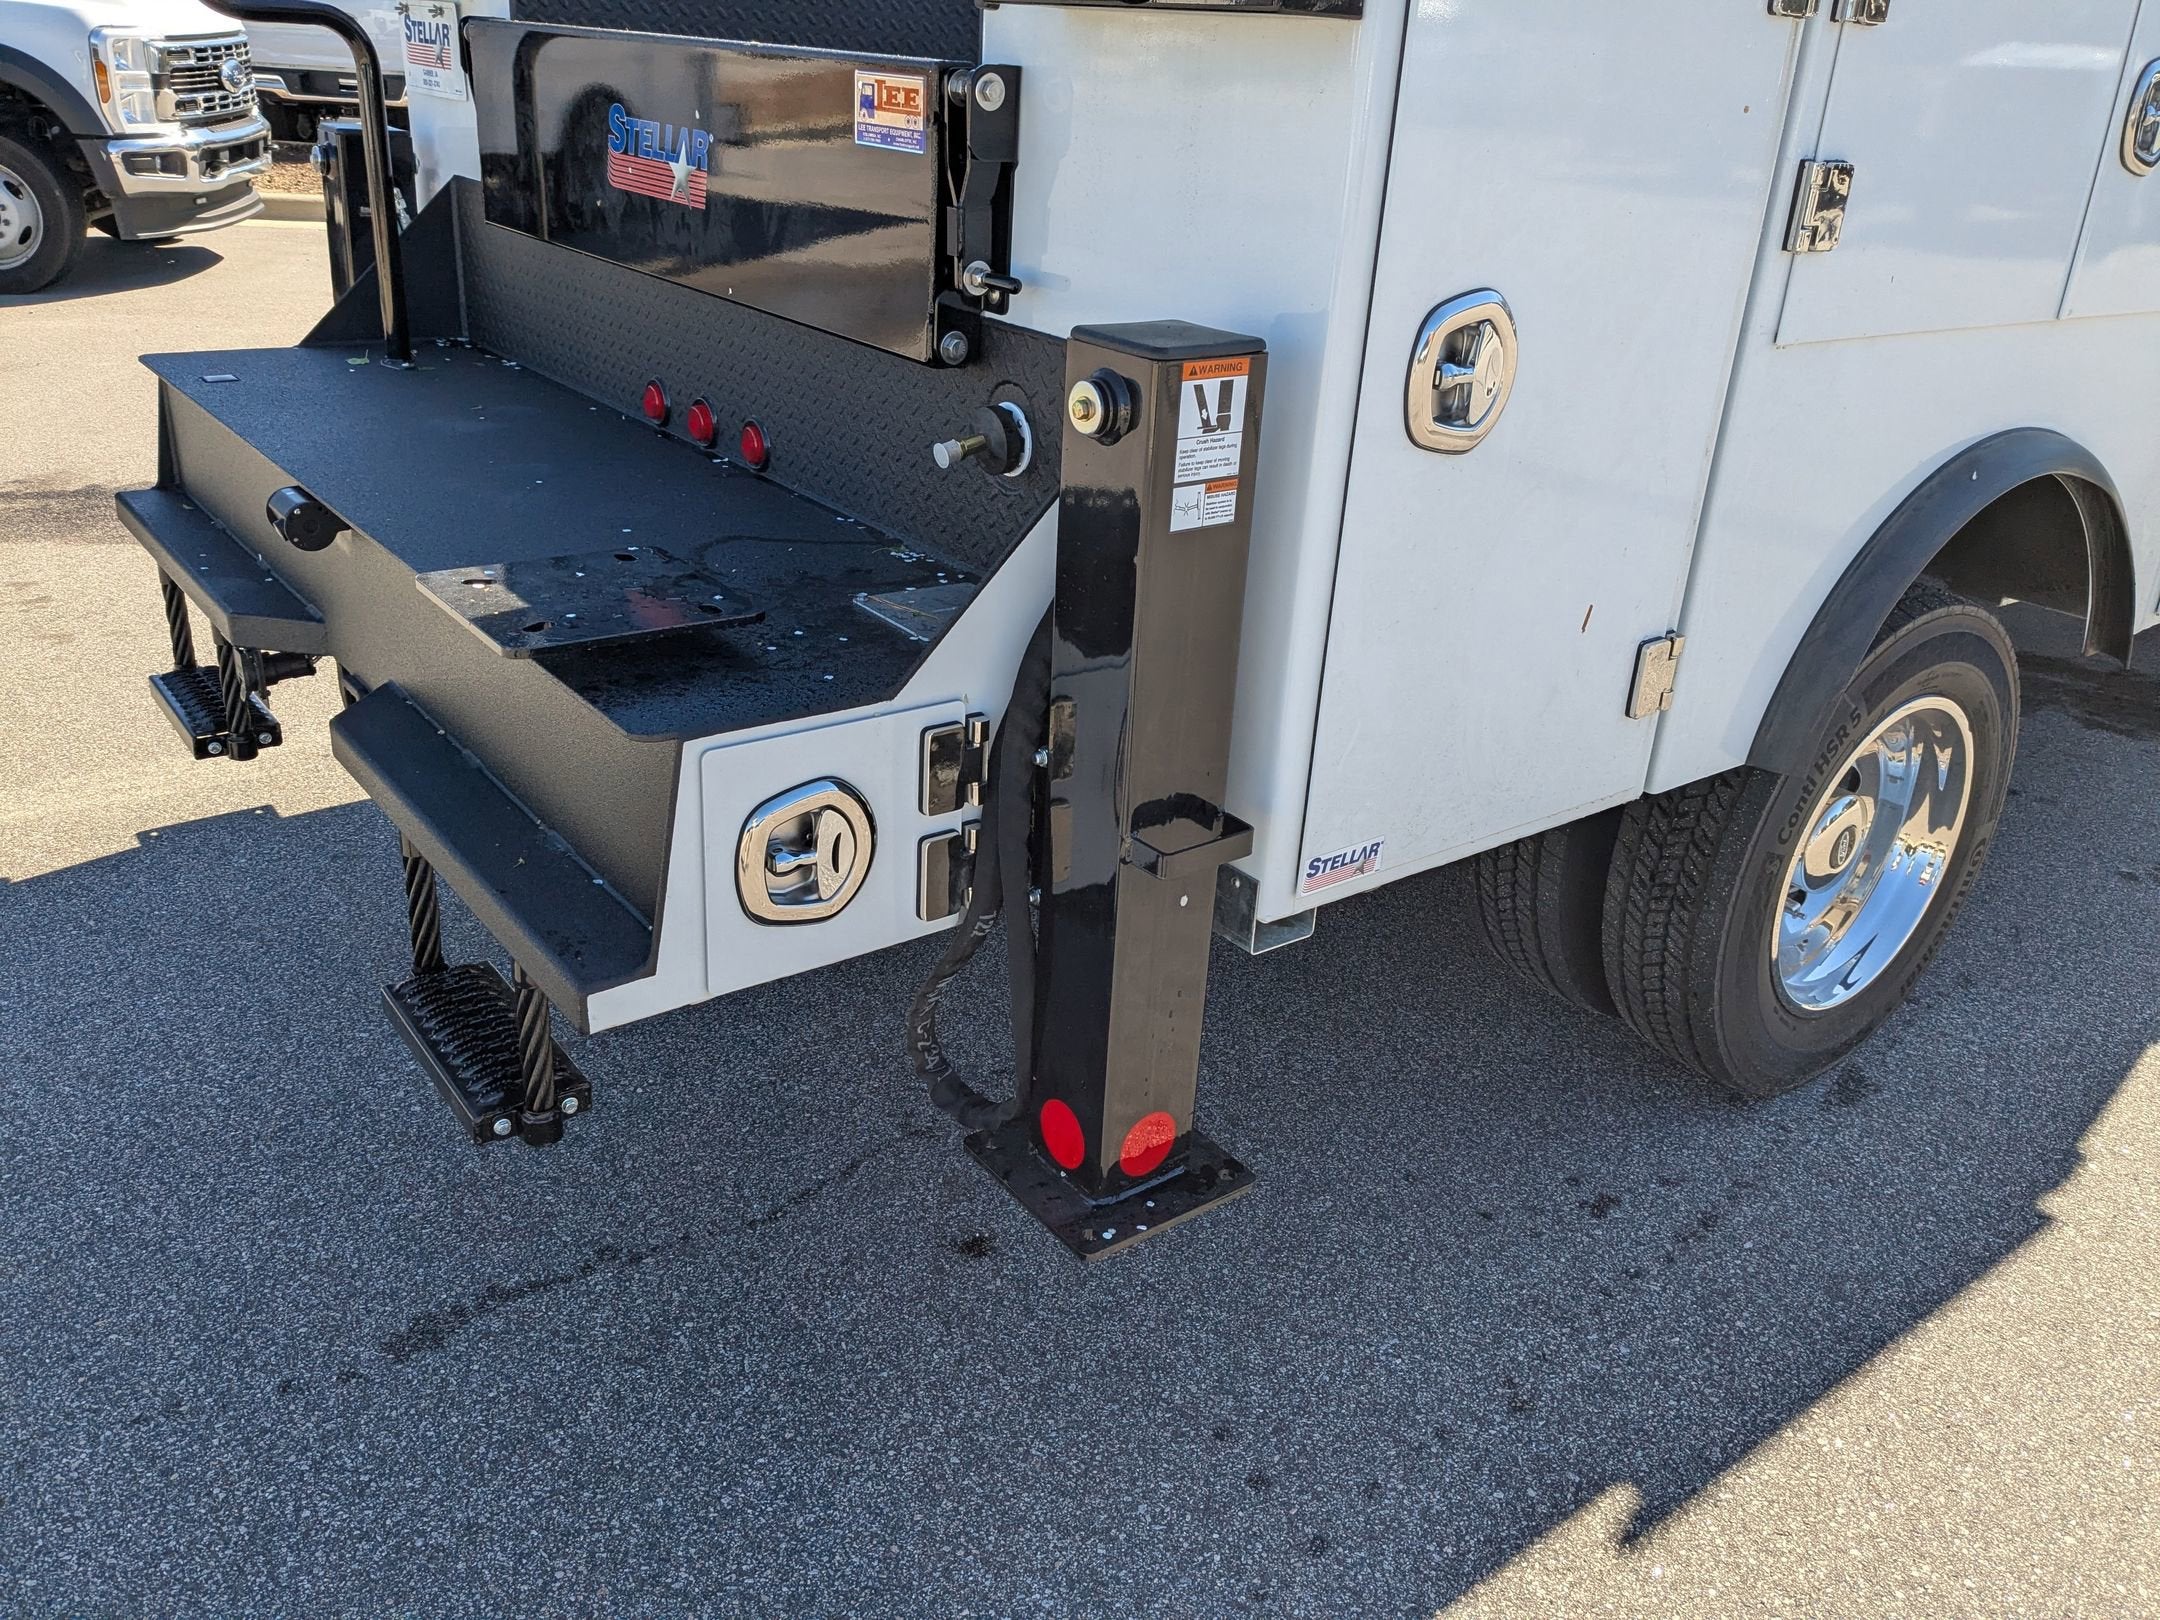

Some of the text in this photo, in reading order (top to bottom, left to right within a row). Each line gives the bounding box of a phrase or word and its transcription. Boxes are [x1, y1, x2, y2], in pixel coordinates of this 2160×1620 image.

[404, 13, 450, 47] STELLAR
[874, 79, 921, 116] LEE
[607, 103, 709, 171] STELLAR
[858, 123, 867, 131] LEE
[867, 125, 889, 134] TRANSPORT
[1198, 362, 1243, 375] WARNING
[1778, 774, 1818, 845] Conti
[1814, 725, 1850, 776] HSR
[1306, 841, 1381, 878] STELLAR
